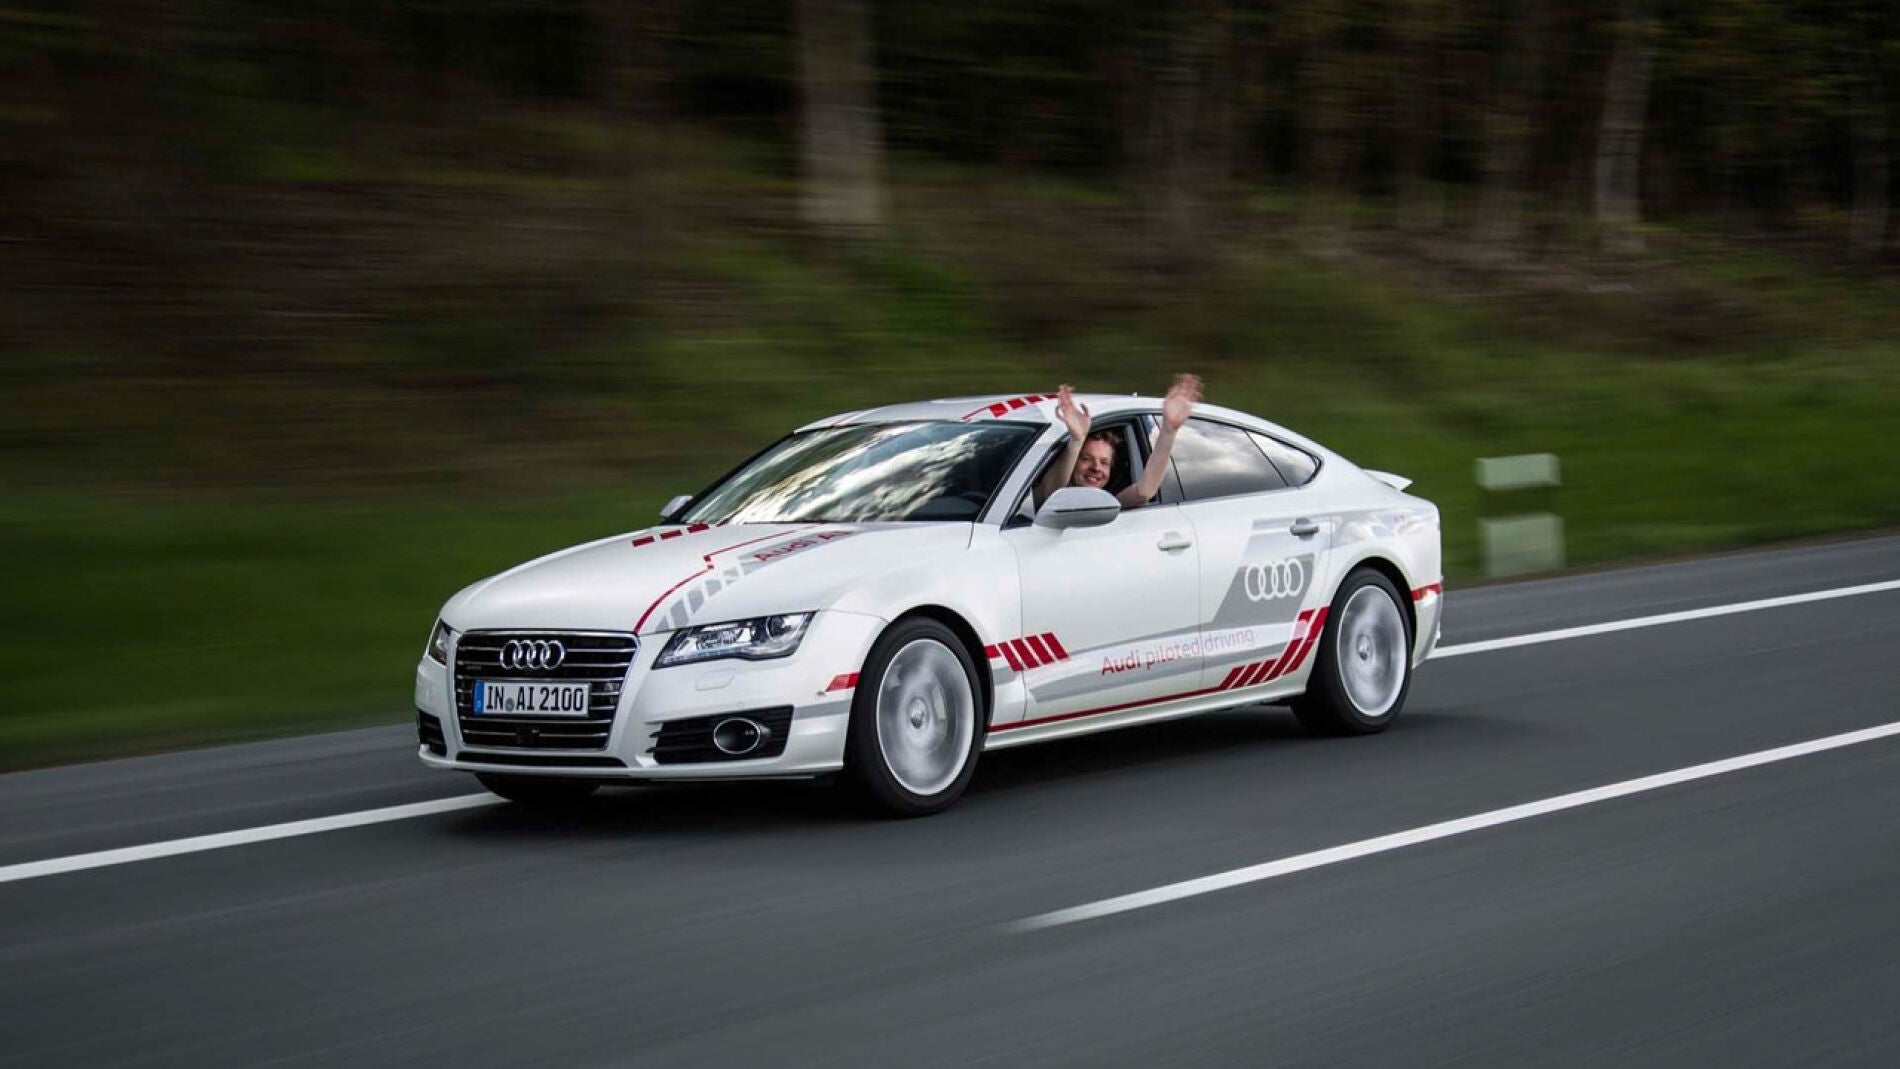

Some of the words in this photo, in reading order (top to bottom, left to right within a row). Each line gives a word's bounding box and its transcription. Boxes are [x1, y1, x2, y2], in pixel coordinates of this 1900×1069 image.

[1101, 651, 1141, 676] Audi
[1146, 635, 1200, 670] piloted
[1203, 629, 1255, 652] driving
[486, 685, 505, 711] IN
[516, 686, 535, 711] AI
[539, 686, 583, 711] 2100
